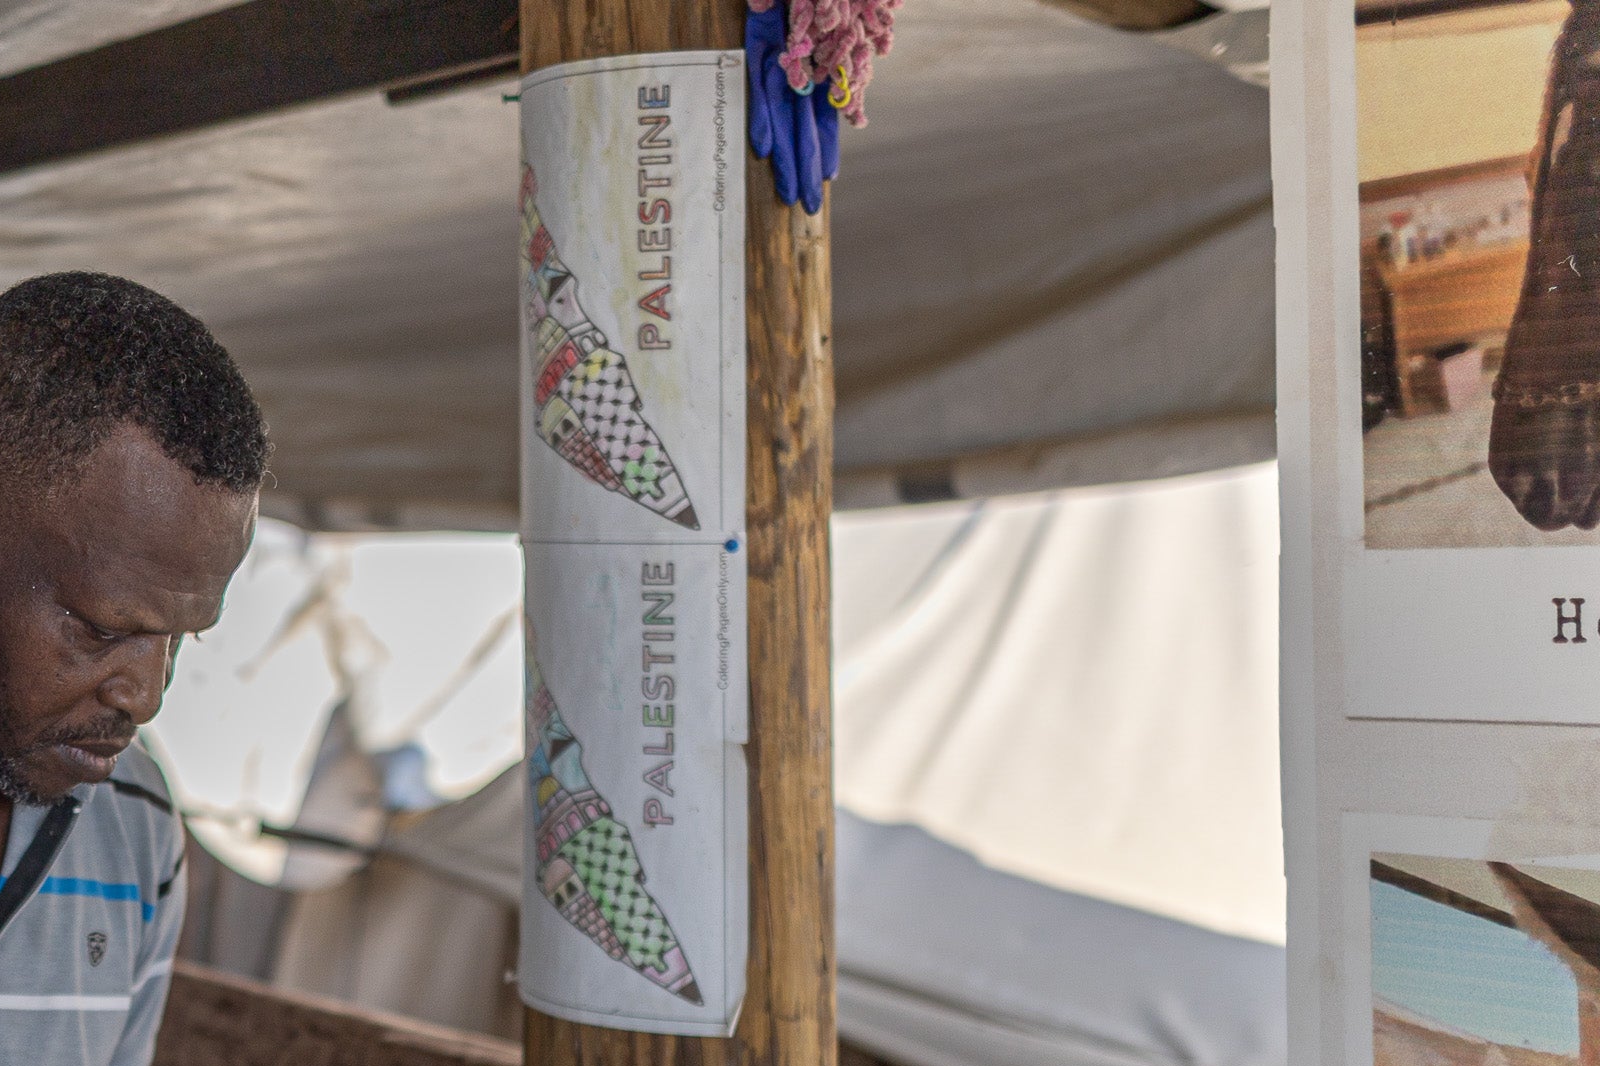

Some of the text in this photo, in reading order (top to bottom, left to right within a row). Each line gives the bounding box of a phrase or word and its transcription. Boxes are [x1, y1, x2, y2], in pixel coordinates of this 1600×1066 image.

[713, 71, 727, 211] ColoringPagesOnly.com
[638, 82, 673, 351] PALESTINE
[716, 552, 730, 691] ColoringPagesOnly.com
[1552, 598, 1600, 644] H
[642, 560, 675, 827] PALESTINE
